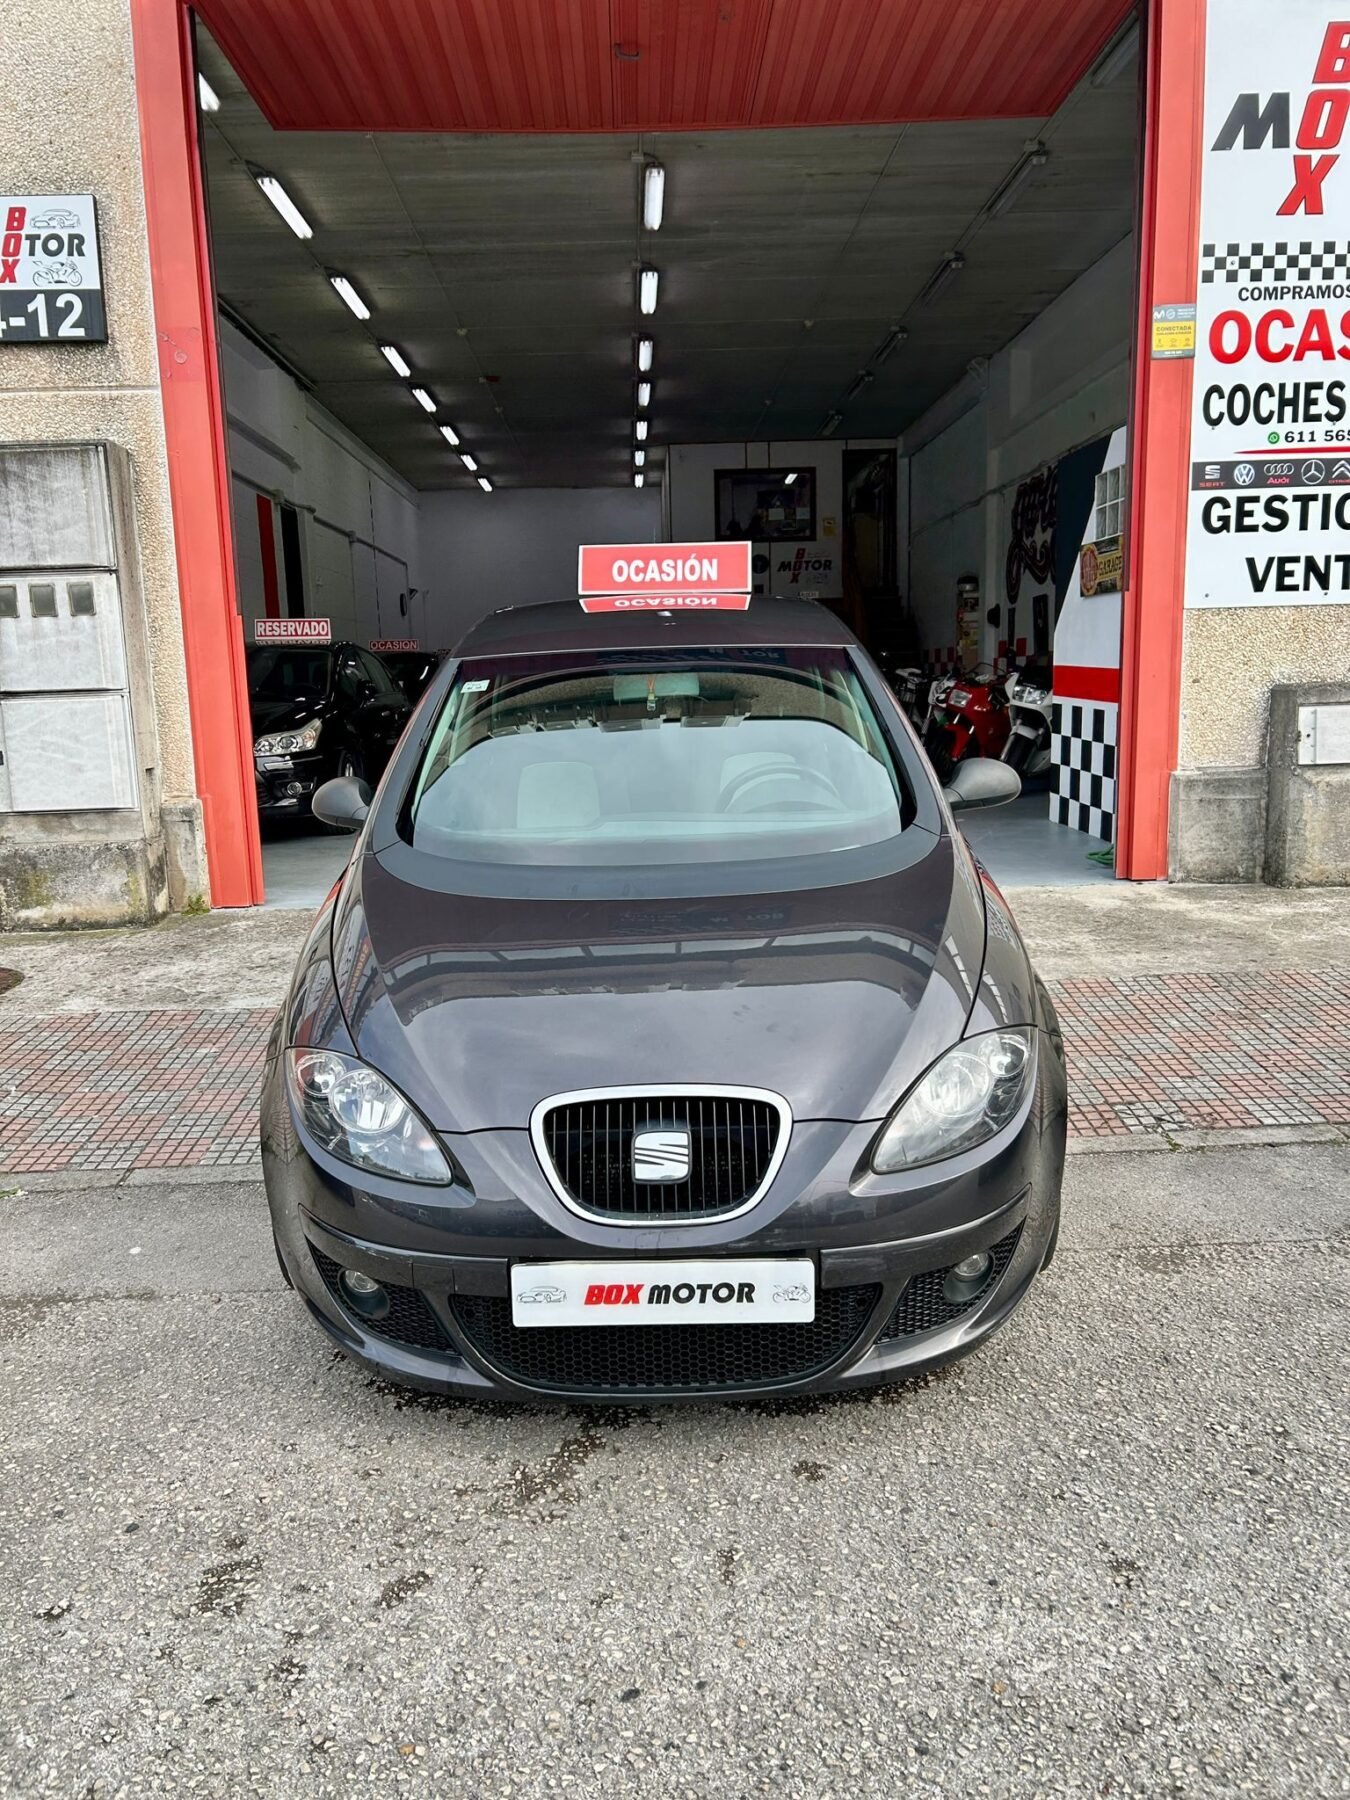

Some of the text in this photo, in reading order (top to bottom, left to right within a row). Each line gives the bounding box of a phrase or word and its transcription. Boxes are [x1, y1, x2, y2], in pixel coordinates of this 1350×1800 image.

[0, 293, 86, 338] -12
[1202, 380, 1347, 427] COCHES
[1284, 430, 1316, 443] 611
[611, 553, 718, 583] OCASIÓN
[1245, 554, 1350, 593] VENT
[256, 621, 328, 636] RESERVADO
[584, 1282, 756, 1305] BOX MOTOR
